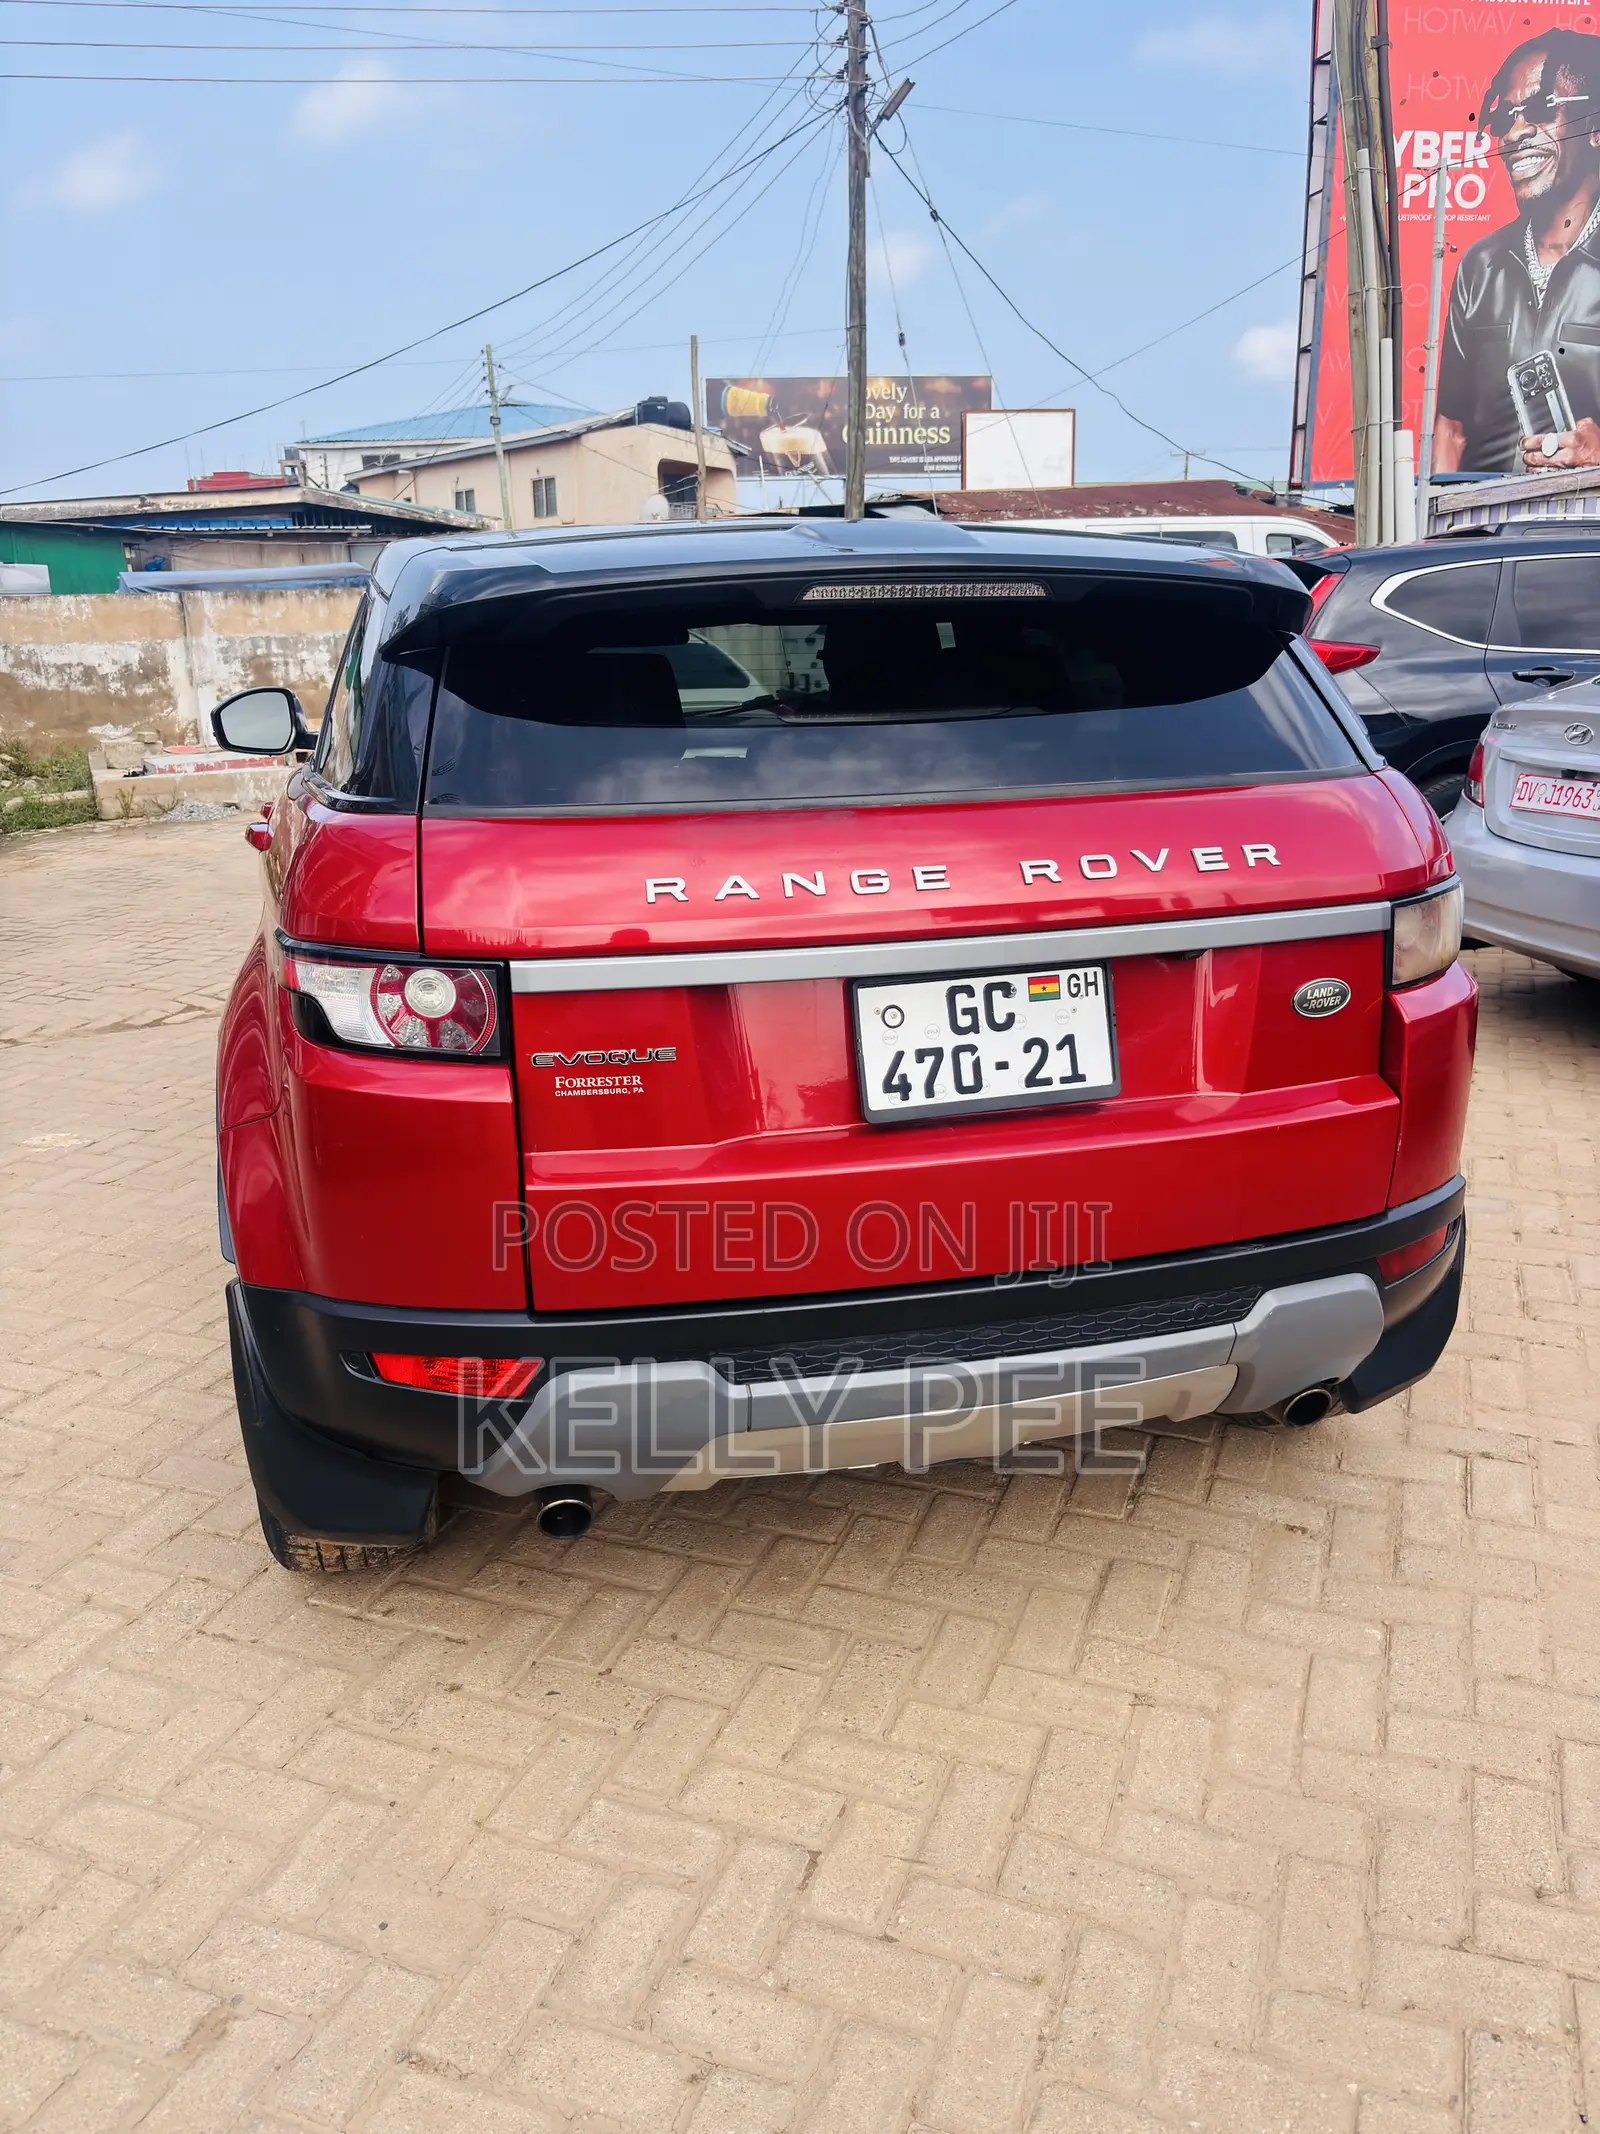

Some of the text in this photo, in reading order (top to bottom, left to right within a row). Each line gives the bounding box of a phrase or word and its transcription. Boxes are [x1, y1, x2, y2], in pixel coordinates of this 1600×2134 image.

[1404, 7, 1515, 35] HOTWAV
[1556, 11, 1600, 35] HO
[1405, 74, 1488, 101] HOTW
[1393, 130, 1491, 169] YBER
[1403, 173, 1486, 209] PRO
[1397, 213, 1491, 222] USTPROOF ROP RESISTANT
[866, 382, 907, 403] ovely
[865, 403, 940, 423] Day for a
[842, 421, 951, 445] uinness
[1517, 782, 1539, 802] DV
[1544, 785, 1595, 809] J1963
[645, 843, 1281, 904] RANGE ROVER
[1067, 971, 1099, 998] GH
[1307, 987, 1333, 999] LAND
[945, 981, 1016, 1035] GC
[1309, 995, 1341, 1009] ROVER
[531, 1046, 677, 1067] EVOQUE
[882, 1034, 1086, 1101] 470-21
[555, 1075, 642, 1089] FORRESTER
[555, 1086, 644, 1098] CHAMBERSBURG, PA
